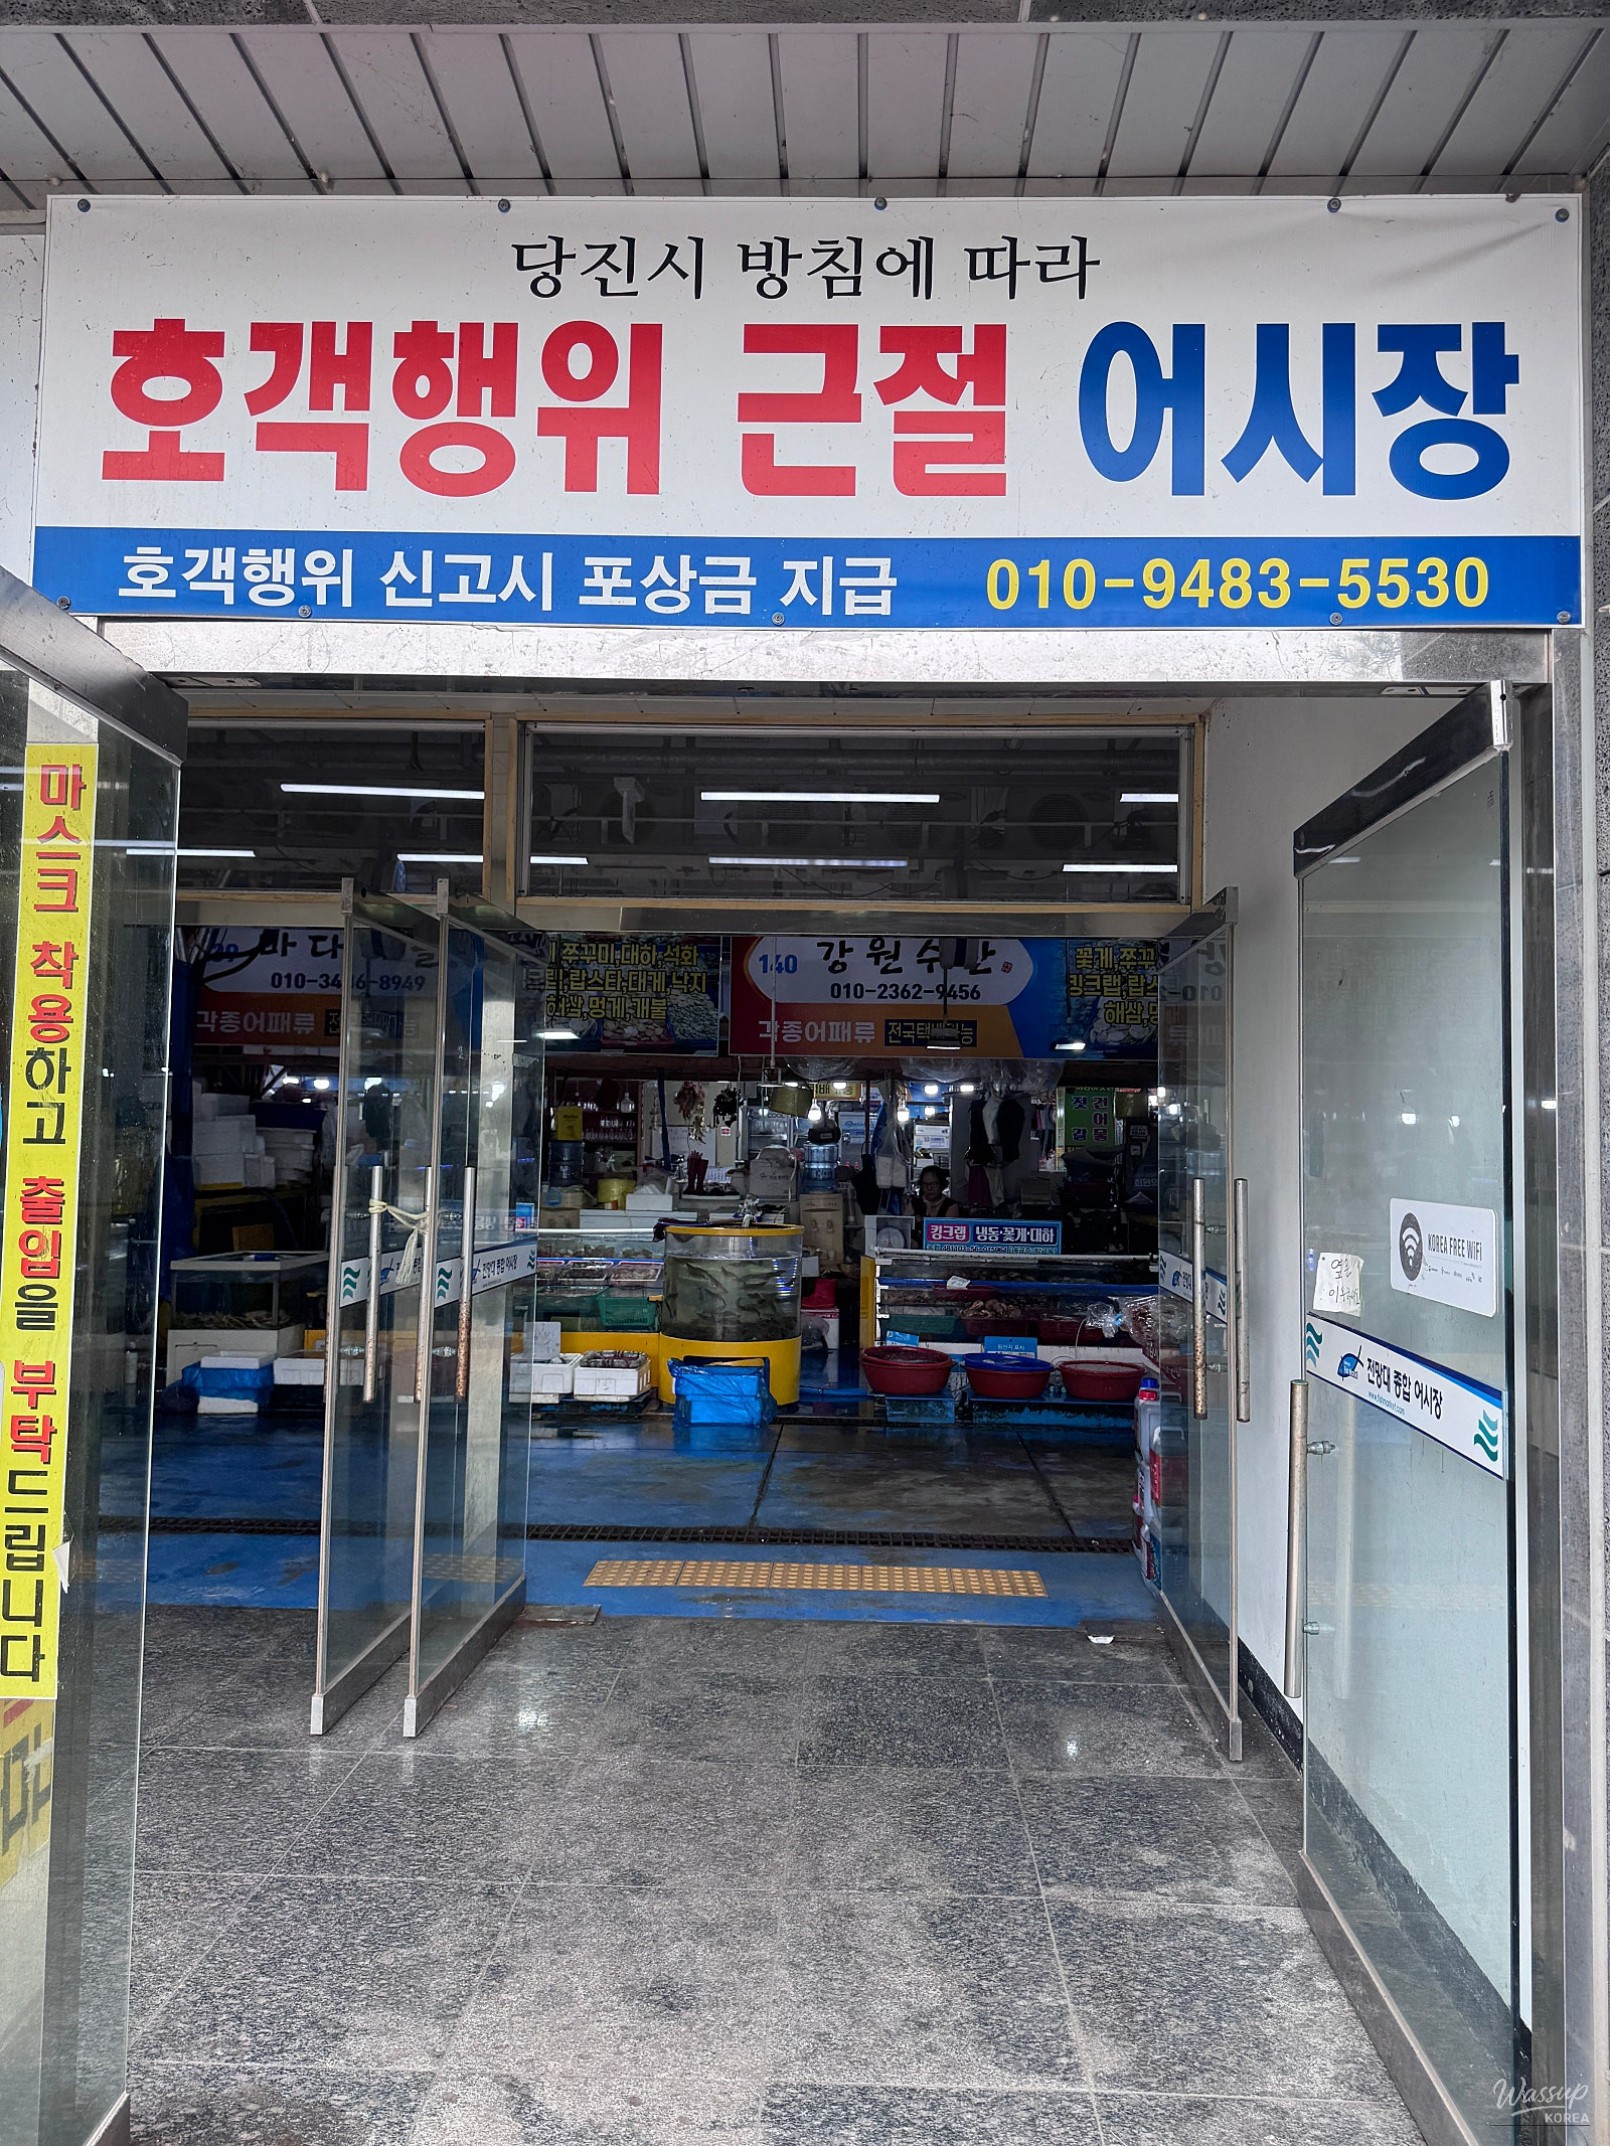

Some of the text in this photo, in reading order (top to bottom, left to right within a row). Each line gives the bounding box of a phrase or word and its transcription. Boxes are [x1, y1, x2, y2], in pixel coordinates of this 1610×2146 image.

[511, 234, 1101, 301] 당진시 방침에 따라
[102, 317, 1520, 500] 호객행위 근절 어시장
[118, 545, 898, 616] 호객행위 신고시 포상금 지급
[985, 556, 1490, 610] 010-9483-5530
[33, 763, 87, 913] 마스크
[271, 972, 426, 990] 010-346-8949
[758, 954, 798, 974] 140
[830, 982, 981, 1000] 010-2362-9456
[22, 940, 80, 1145] 착용하고
[196, 1010, 315, 1034] 각종어패류
[758, 1019, 974, 1046] 각종어패류 전국택능
[14, 1175, 66, 1332] 출입을
[930, 1224, 967, 1241] 킹크랩
[1427, 1233, 1483, 1262] KOREA FREE WiFi
[1367, 1357, 1391, 1393] 전망대
[1393, 1369, 1411, 1403] 종합
[1414, 1379, 1443, 1420] 어시장
[1, 1359, 58, 1683] 부탁드립니다
